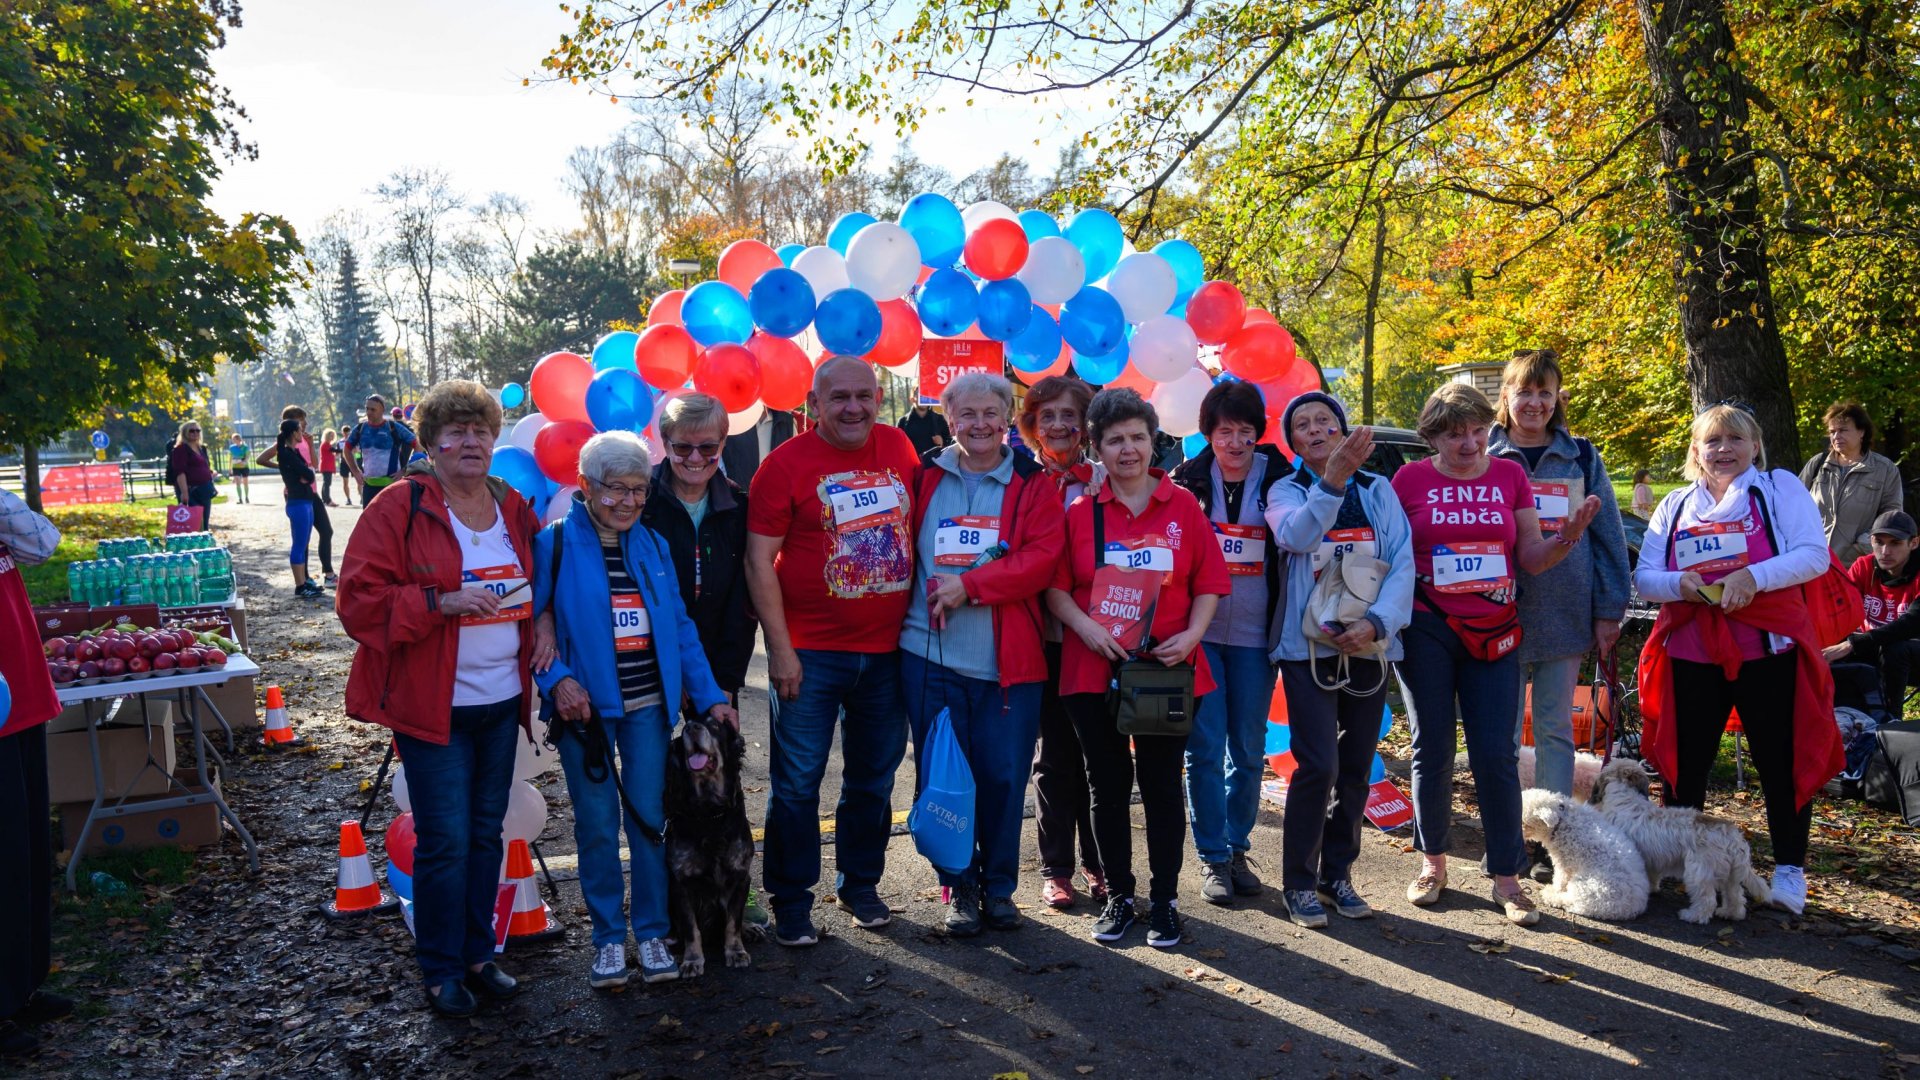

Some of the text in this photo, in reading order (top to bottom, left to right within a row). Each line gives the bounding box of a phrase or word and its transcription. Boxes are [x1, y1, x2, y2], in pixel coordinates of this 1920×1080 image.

[851, 490, 879, 508] 150
[1427, 485, 1505, 504] SENZA
[1534, 496, 1542, 511] 1
[1431, 507, 1504, 525] babča
[959, 529, 980, 545] 88
[1223, 538, 1244, 554] 86
[1694, 536, 1722, 554] 141
[1127, 549, 1152, 568] 120
[1454, 557, 1483, 573] 107
[1106, 584, 1144, 603] JSEM
[611, 610, 640, 628] 105
[1100, 600, 1142, 621] SOKOL
[926, 801, 958, 825] EXTRA
[1368, 798, 1409, 819] NAZDAR
